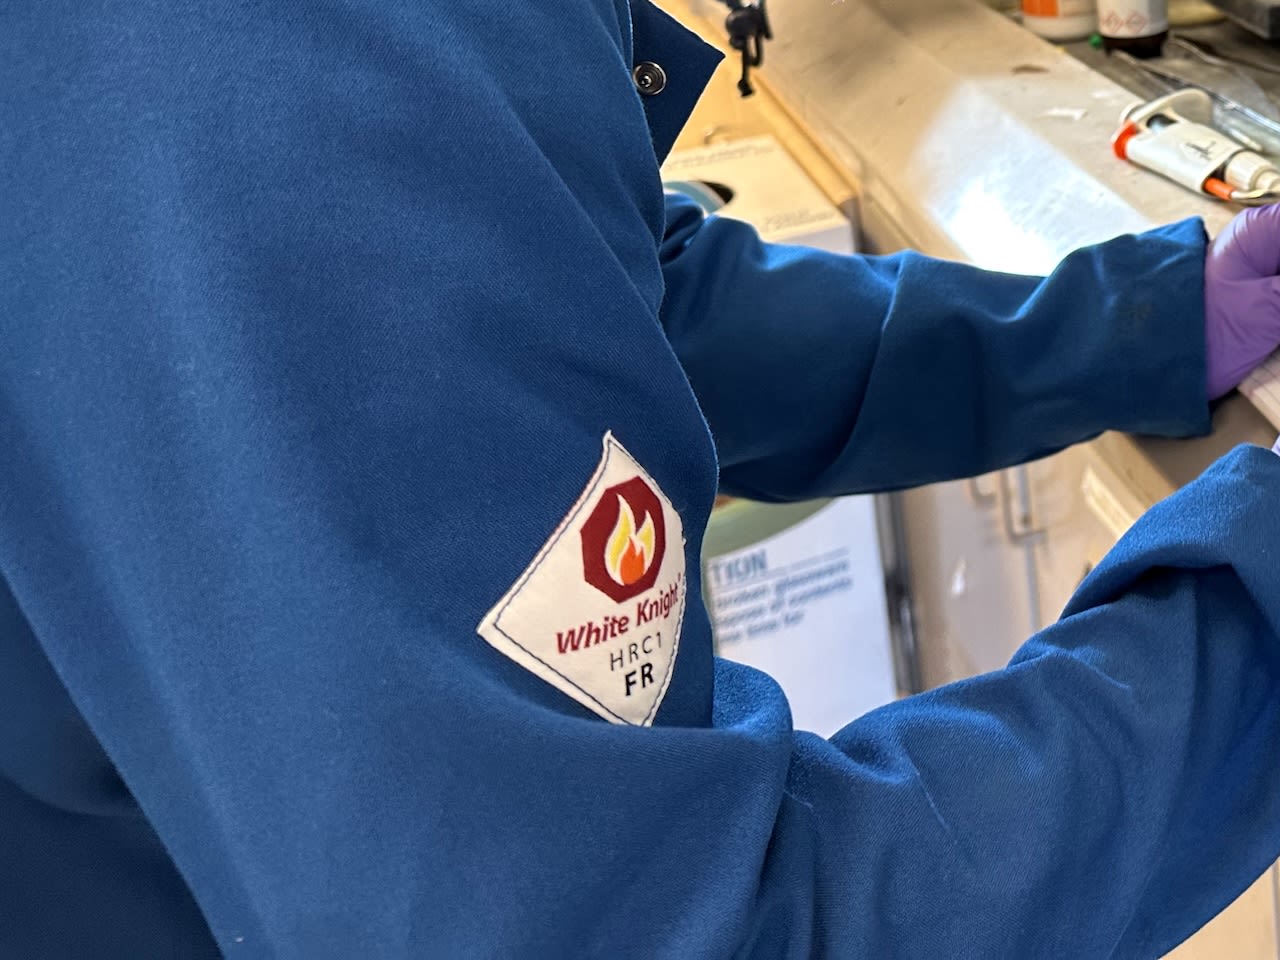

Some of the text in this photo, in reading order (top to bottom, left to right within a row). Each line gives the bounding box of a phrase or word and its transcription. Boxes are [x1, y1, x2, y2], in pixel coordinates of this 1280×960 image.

[556, 615, 630, 655] White
[636, 582, 680, 627] Knight
[610, 631, 662, 672] HRC1
[624, 662, 655, 697] FR
